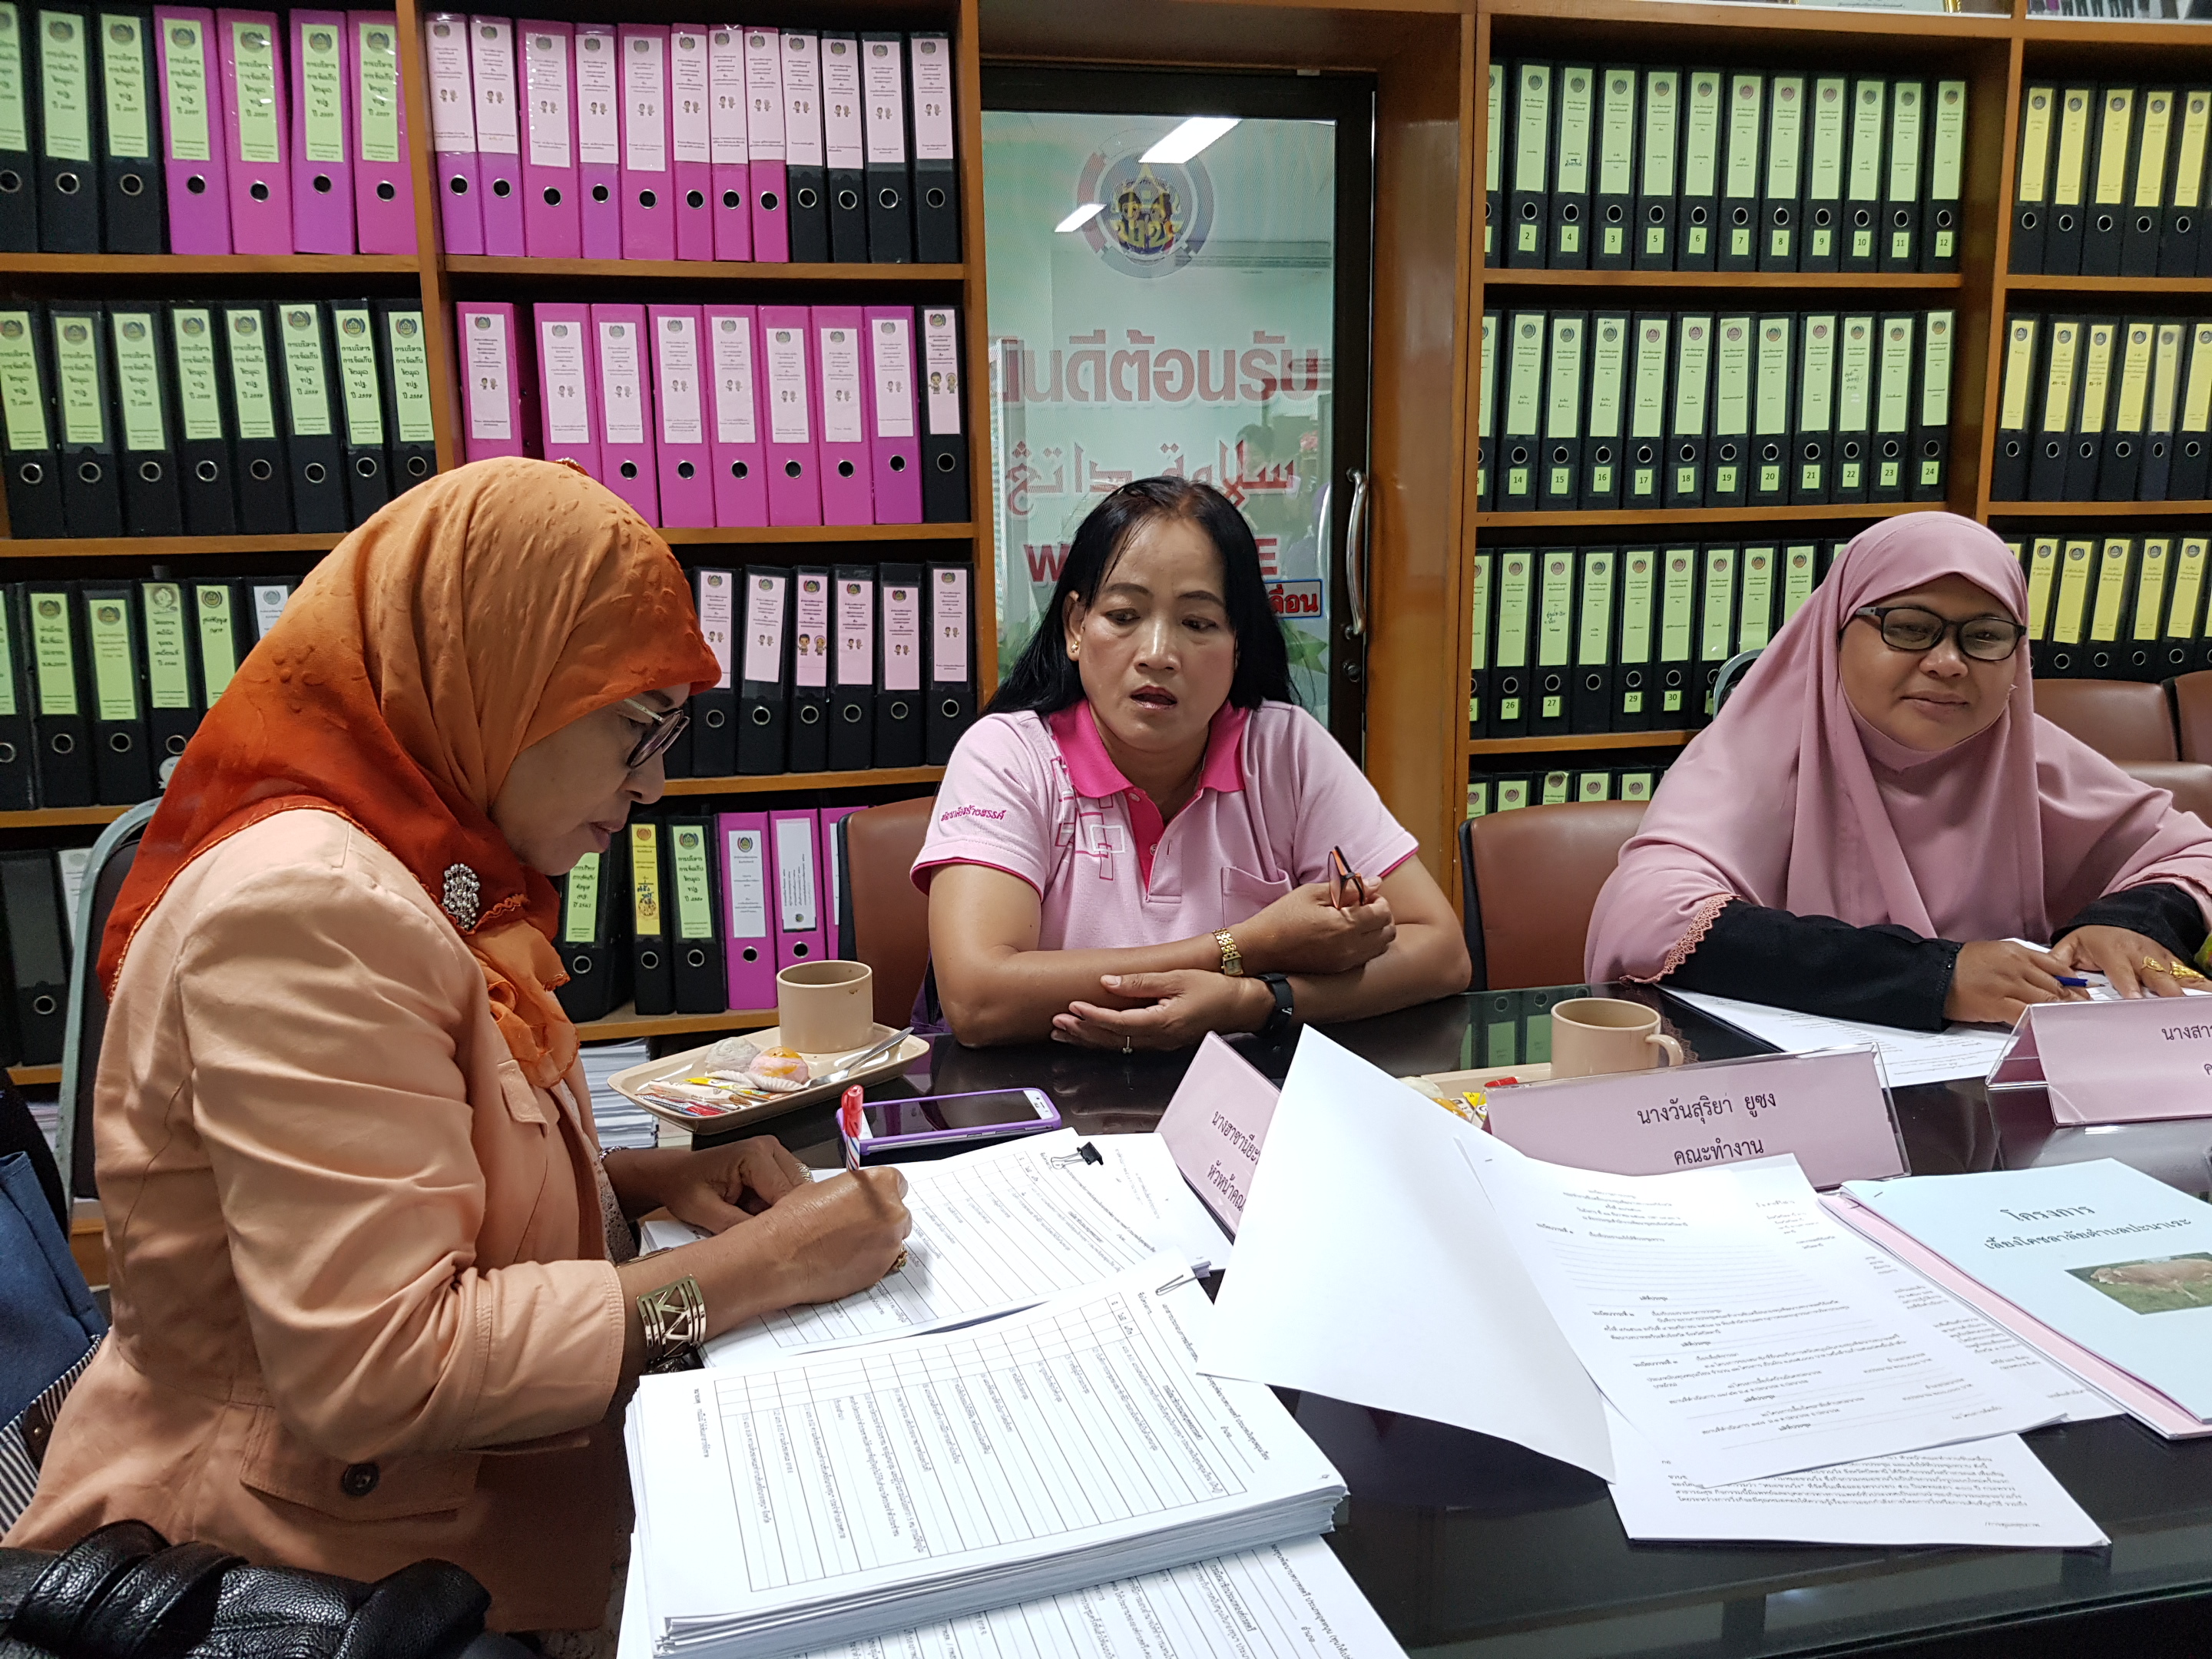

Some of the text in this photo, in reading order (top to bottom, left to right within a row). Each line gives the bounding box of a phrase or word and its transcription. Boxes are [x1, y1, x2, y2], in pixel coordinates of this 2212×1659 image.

[988, 329, 1318, 402] ินดีต้อนรับ
[2161, 1025, 2212, 1041] นางสา
[1674, 1137, 1764, 1166] คณะทำงาน
[1999, 1206, 2095, 1222] โครงการ
[1268, 1541, 1311, 1600] องทุนพัฒนาบทบาทสตรี
